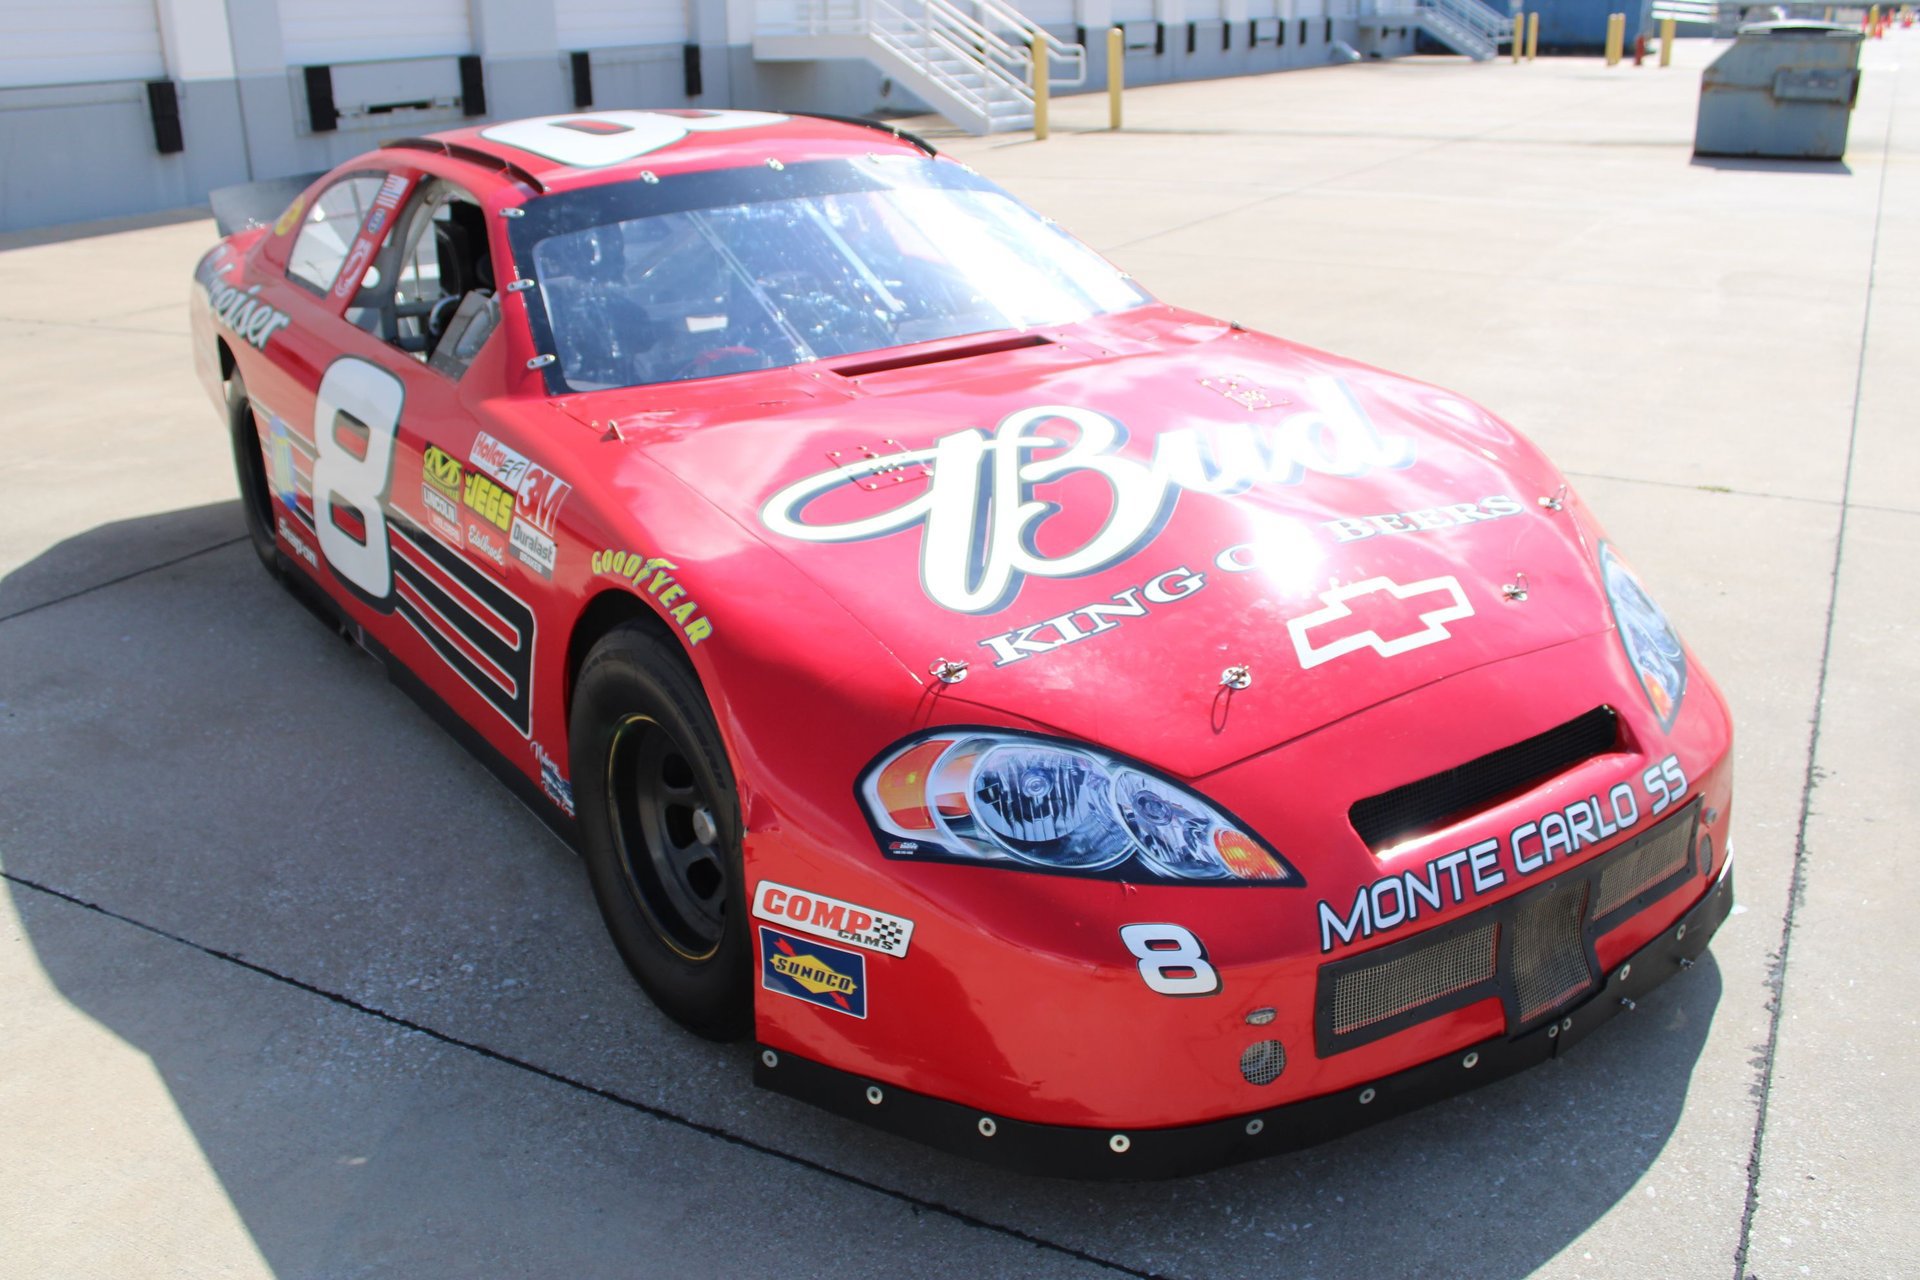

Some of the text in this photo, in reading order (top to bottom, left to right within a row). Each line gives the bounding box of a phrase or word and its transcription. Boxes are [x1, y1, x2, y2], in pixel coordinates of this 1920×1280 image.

[480, 109, 792, 168] 8
[312, 355, 405, 604] 8
[463, 471, 515, 532] JEGS
[518, 467, 568, 533] 3M
[758, 374, 1417, 616] Bud
[513, 522, 554, 563] Duralast
[978, 566, 1206, 667] KING
[1321, 494, 1524, 544] BEERS
[1316, 754, 1689, 953] MONTE CARLO SS
[762, 888, 872, 934] COMP
[837, 928, 894, 951] CAMS
[775, 957, 851, 992] SUNOCO
[1118, 922, 1222, 996] 8
